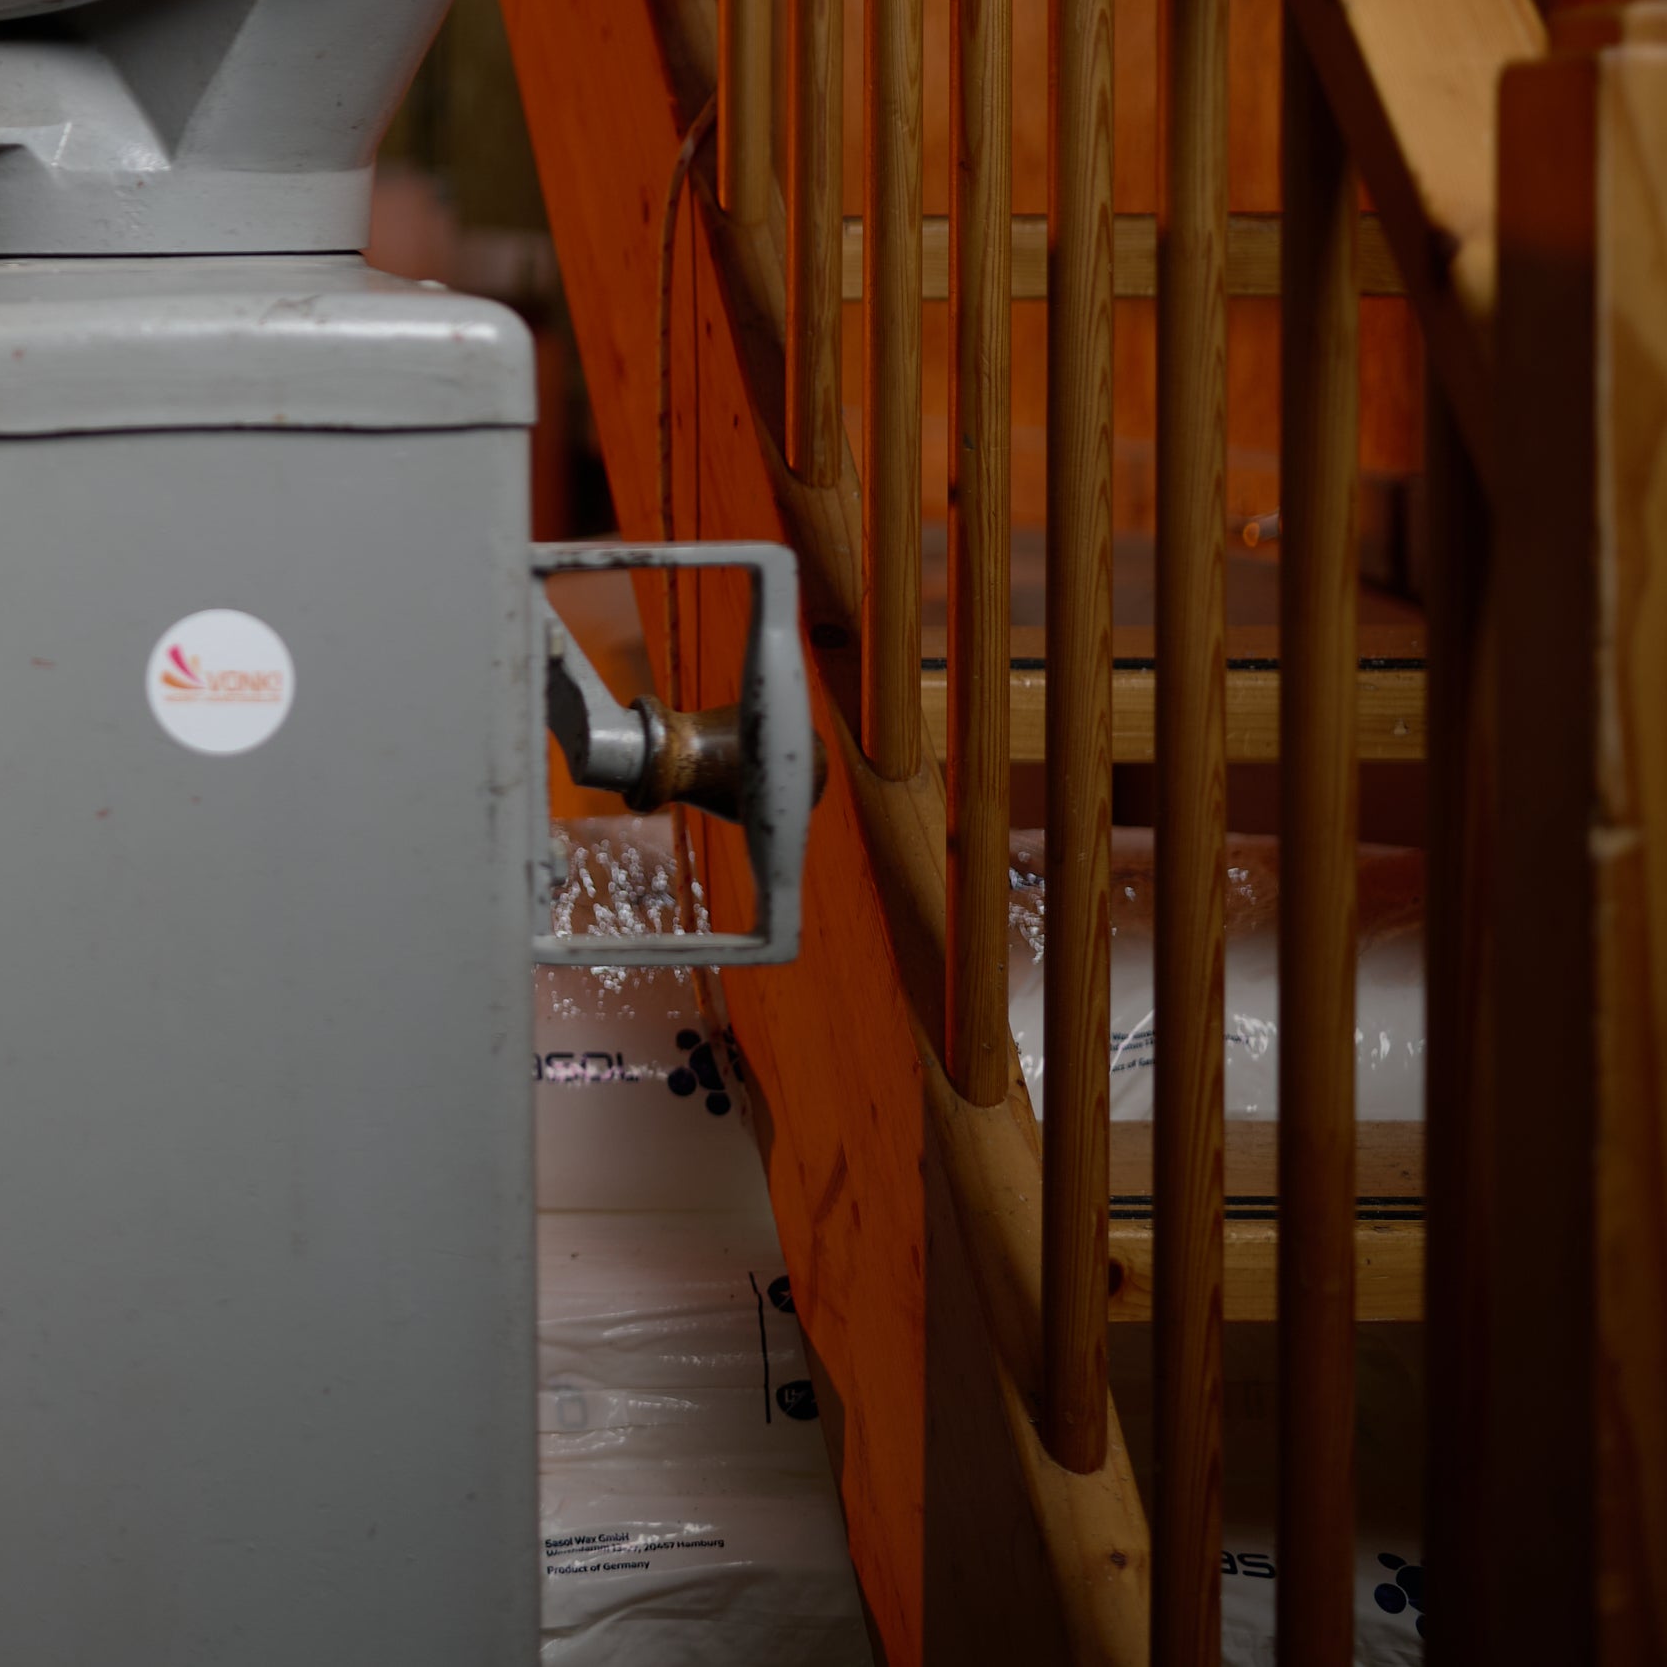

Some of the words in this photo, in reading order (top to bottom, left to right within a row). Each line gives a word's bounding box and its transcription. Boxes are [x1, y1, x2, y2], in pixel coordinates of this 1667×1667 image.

[545, 1537, 574, 1548] Sasol
[574, 1535, 597, 1545] Wax
[598, 1532, 630, 1543] GmbH
[677, 1539, 725, 1549] Hamburg
[546, 1565, 588, 1575] Product
[590, 1563, 601, 1572] of
[603, 1560, 650, 1571] Germany
